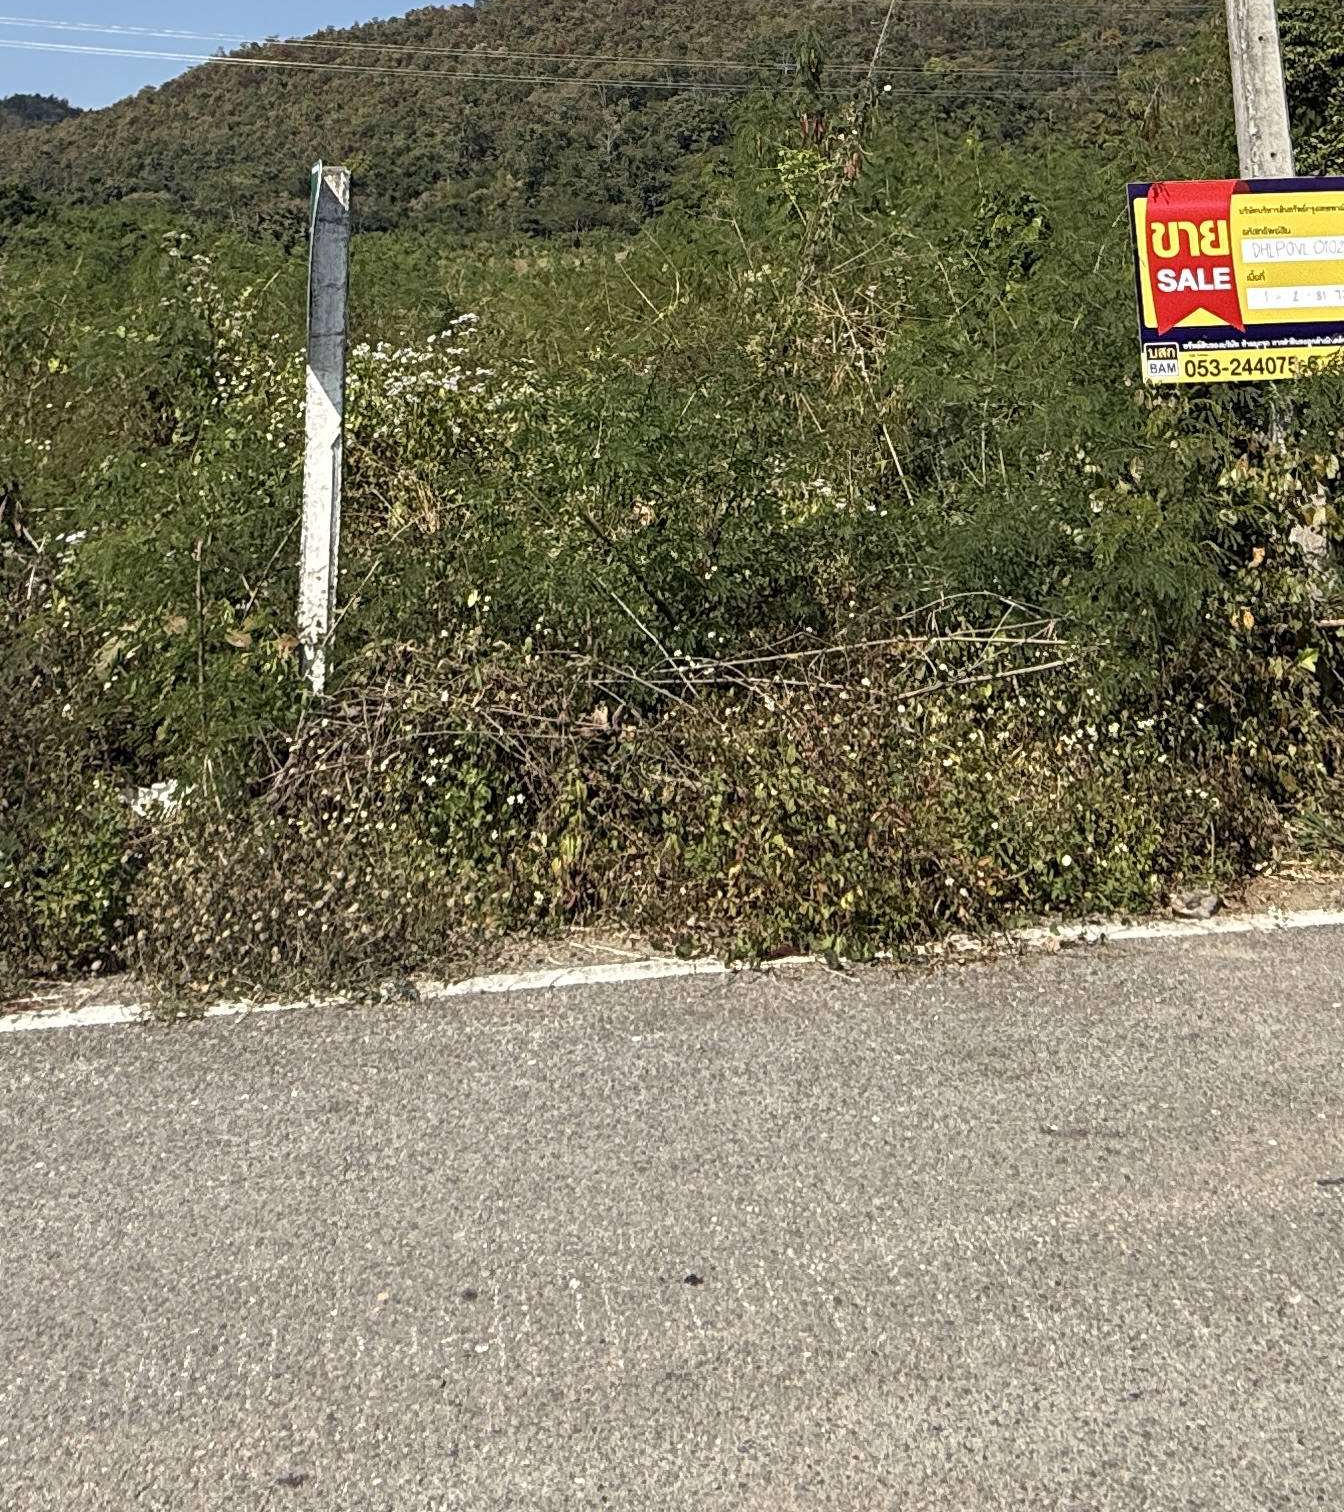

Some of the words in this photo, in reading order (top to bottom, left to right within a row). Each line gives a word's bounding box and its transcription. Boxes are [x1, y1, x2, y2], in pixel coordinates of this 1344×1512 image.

[1151, 219, 1230, 259] ขาย
[1157, 266, 1232, 292] SALE
[1149, 362, 1177, 374] BAM
